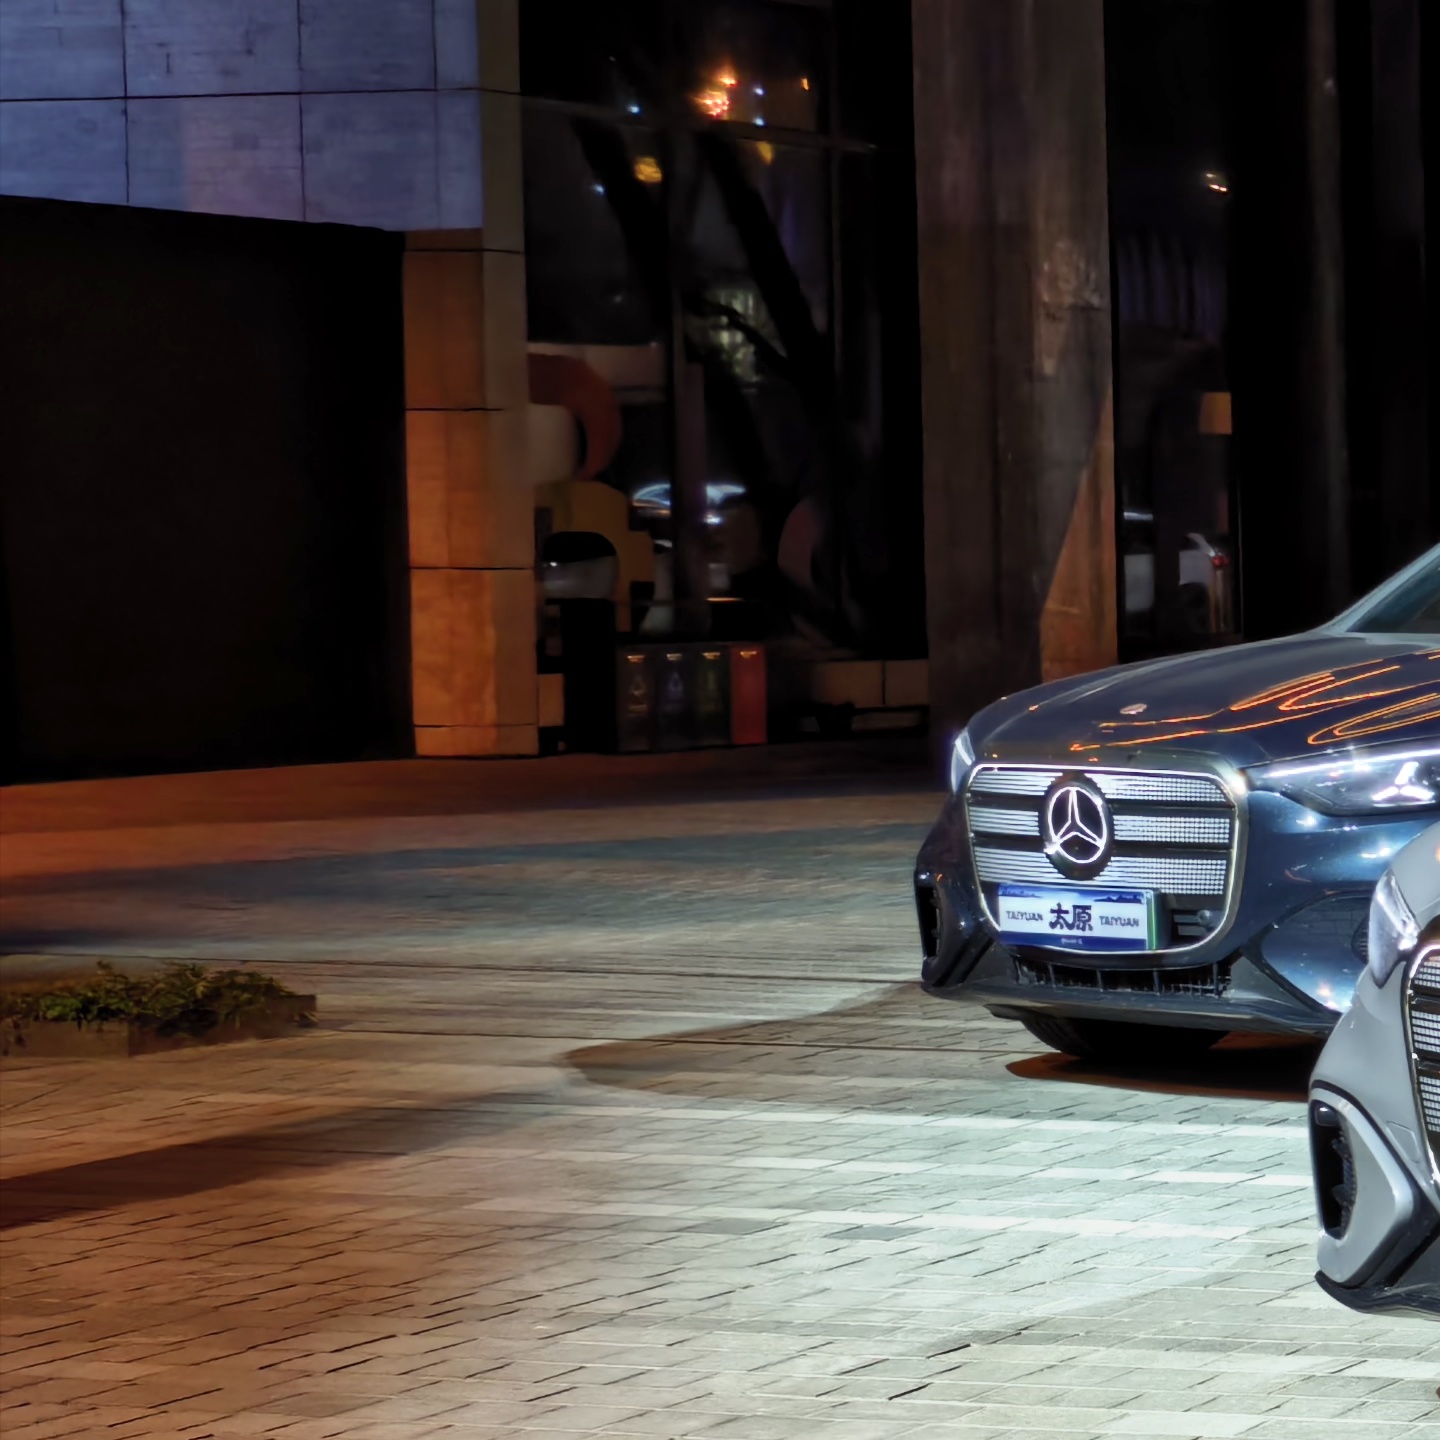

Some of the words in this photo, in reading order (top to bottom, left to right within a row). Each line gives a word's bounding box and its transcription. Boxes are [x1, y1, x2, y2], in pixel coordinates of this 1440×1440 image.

[1005, 910, 1043, 922] TAIYUAN
[1049, 902, 1093, 932] 太原
[1099, 915, 1139, 927] TAIYUAN
